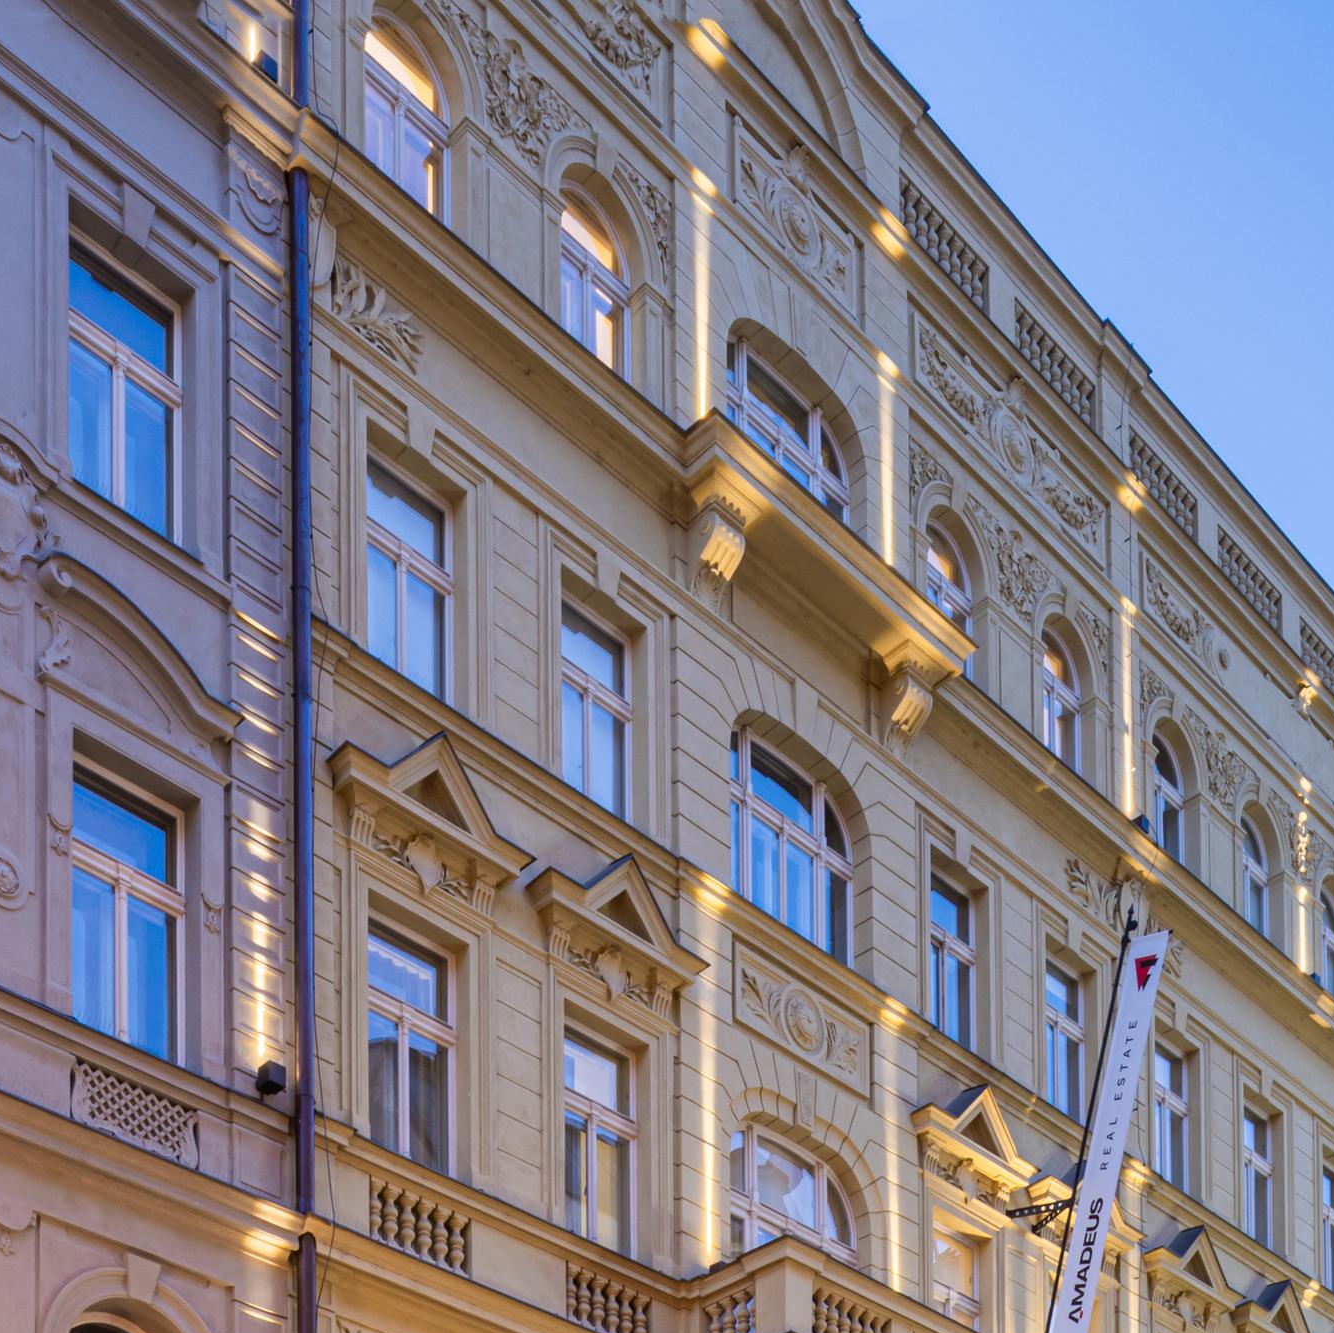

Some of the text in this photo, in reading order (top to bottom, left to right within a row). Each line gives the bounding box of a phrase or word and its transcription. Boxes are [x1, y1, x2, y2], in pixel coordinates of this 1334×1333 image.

[1068, 1019, 1138, 1324] AMADEUS REAL ESTATE
